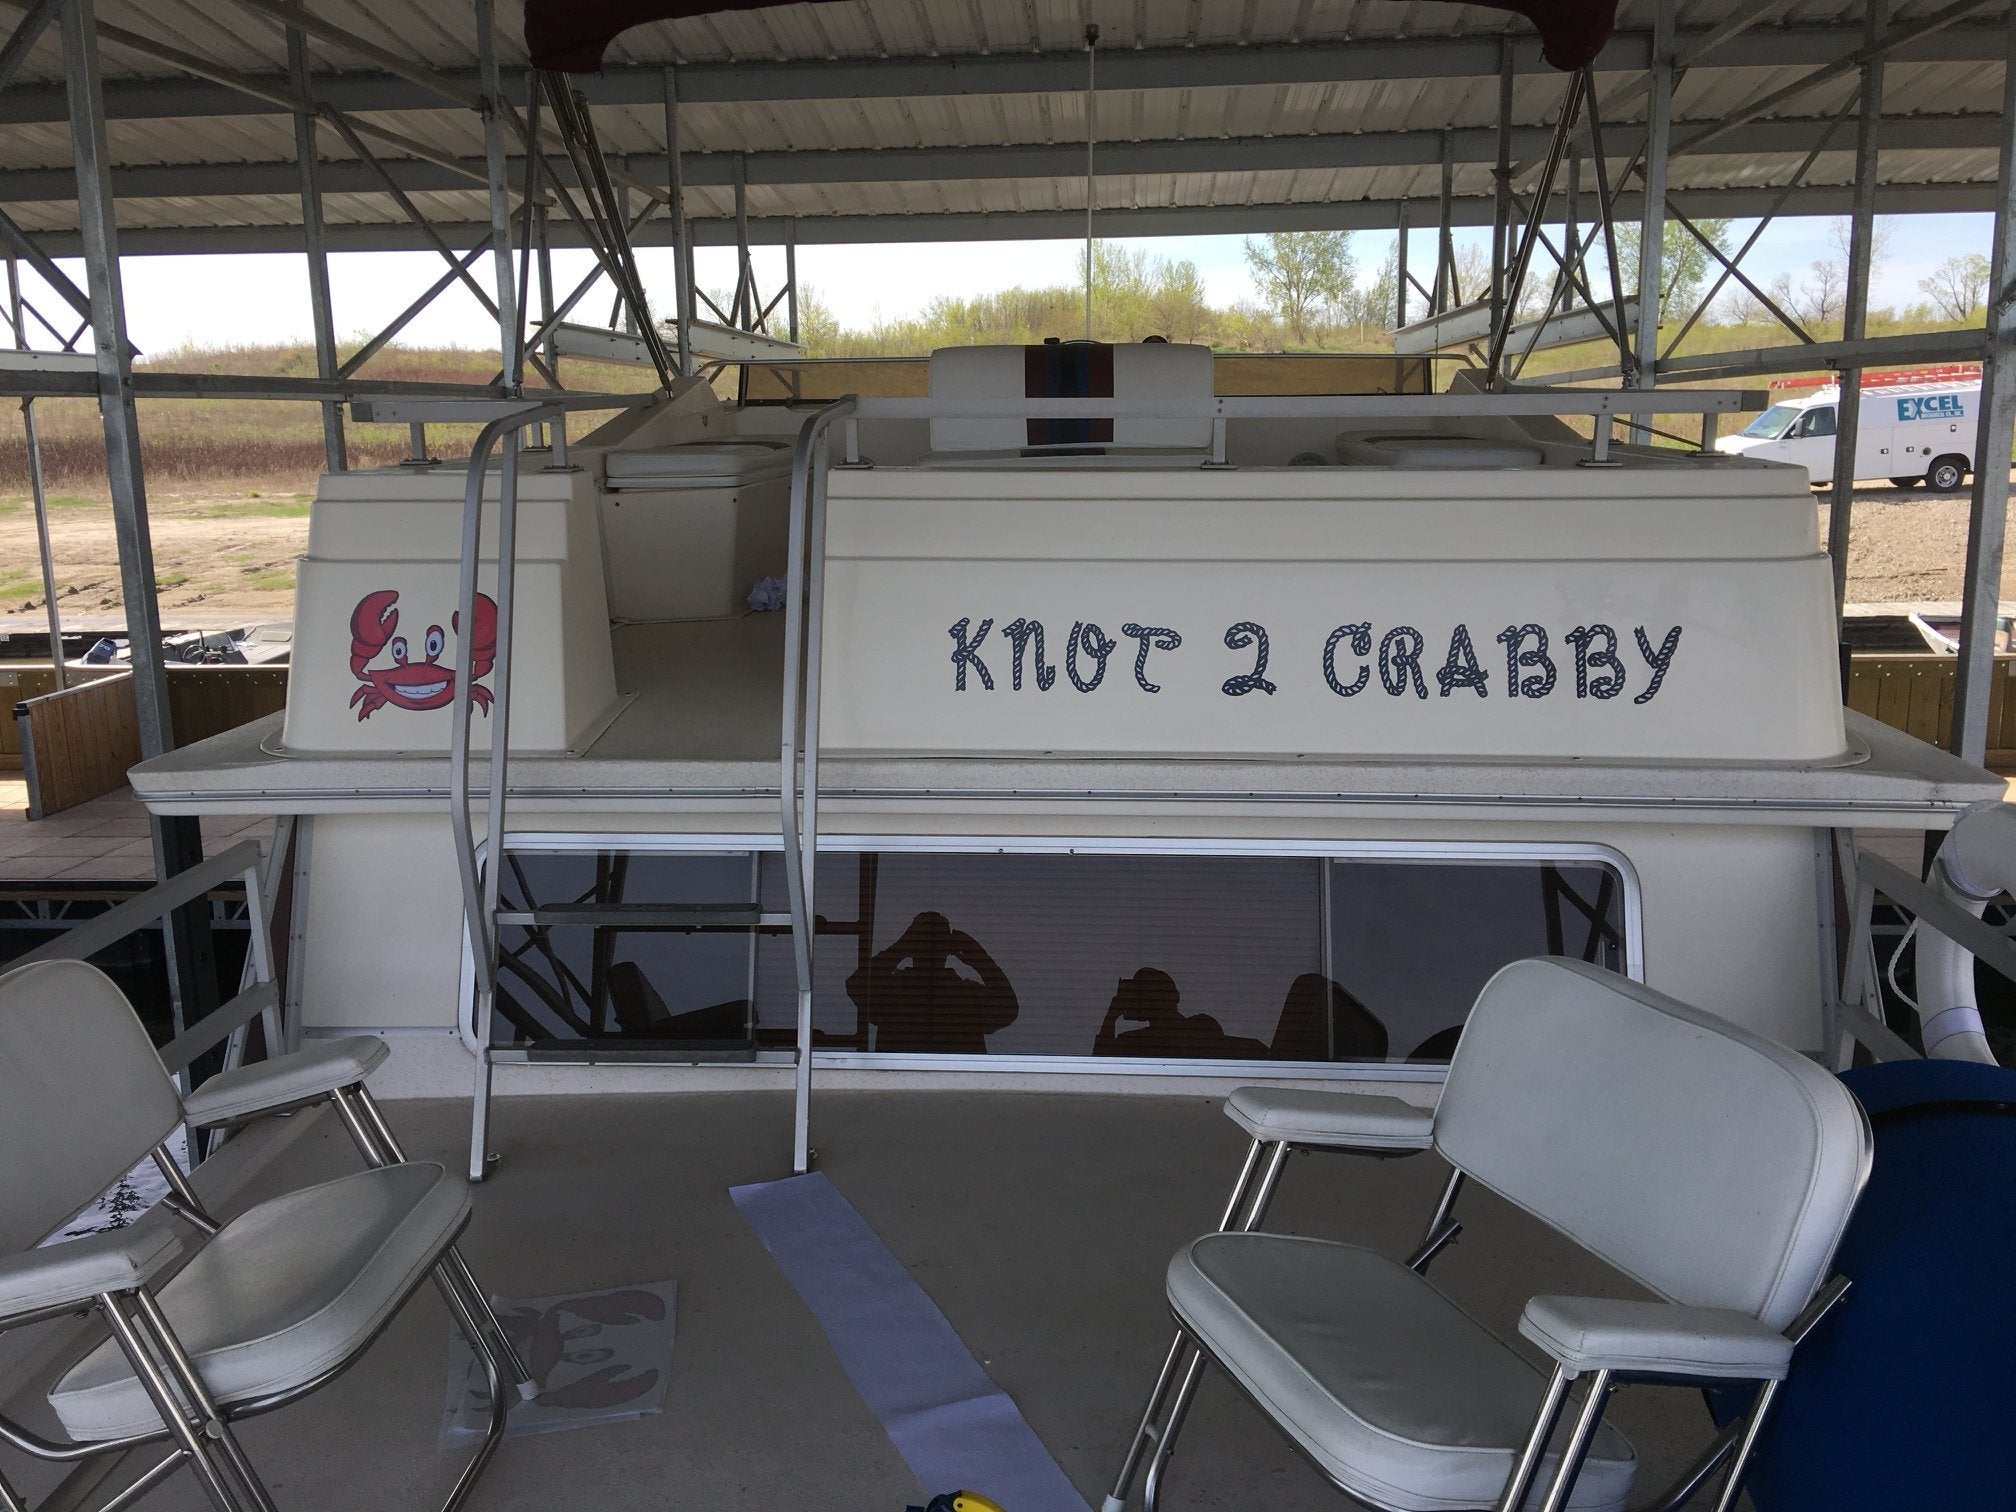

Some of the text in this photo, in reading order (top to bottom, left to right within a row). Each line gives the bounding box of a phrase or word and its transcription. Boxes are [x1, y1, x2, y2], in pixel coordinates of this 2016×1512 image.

[1897, 395, 1964, 421] EXCEL
[947, 617, 1682, 704] KNOT 2 CRABBY
